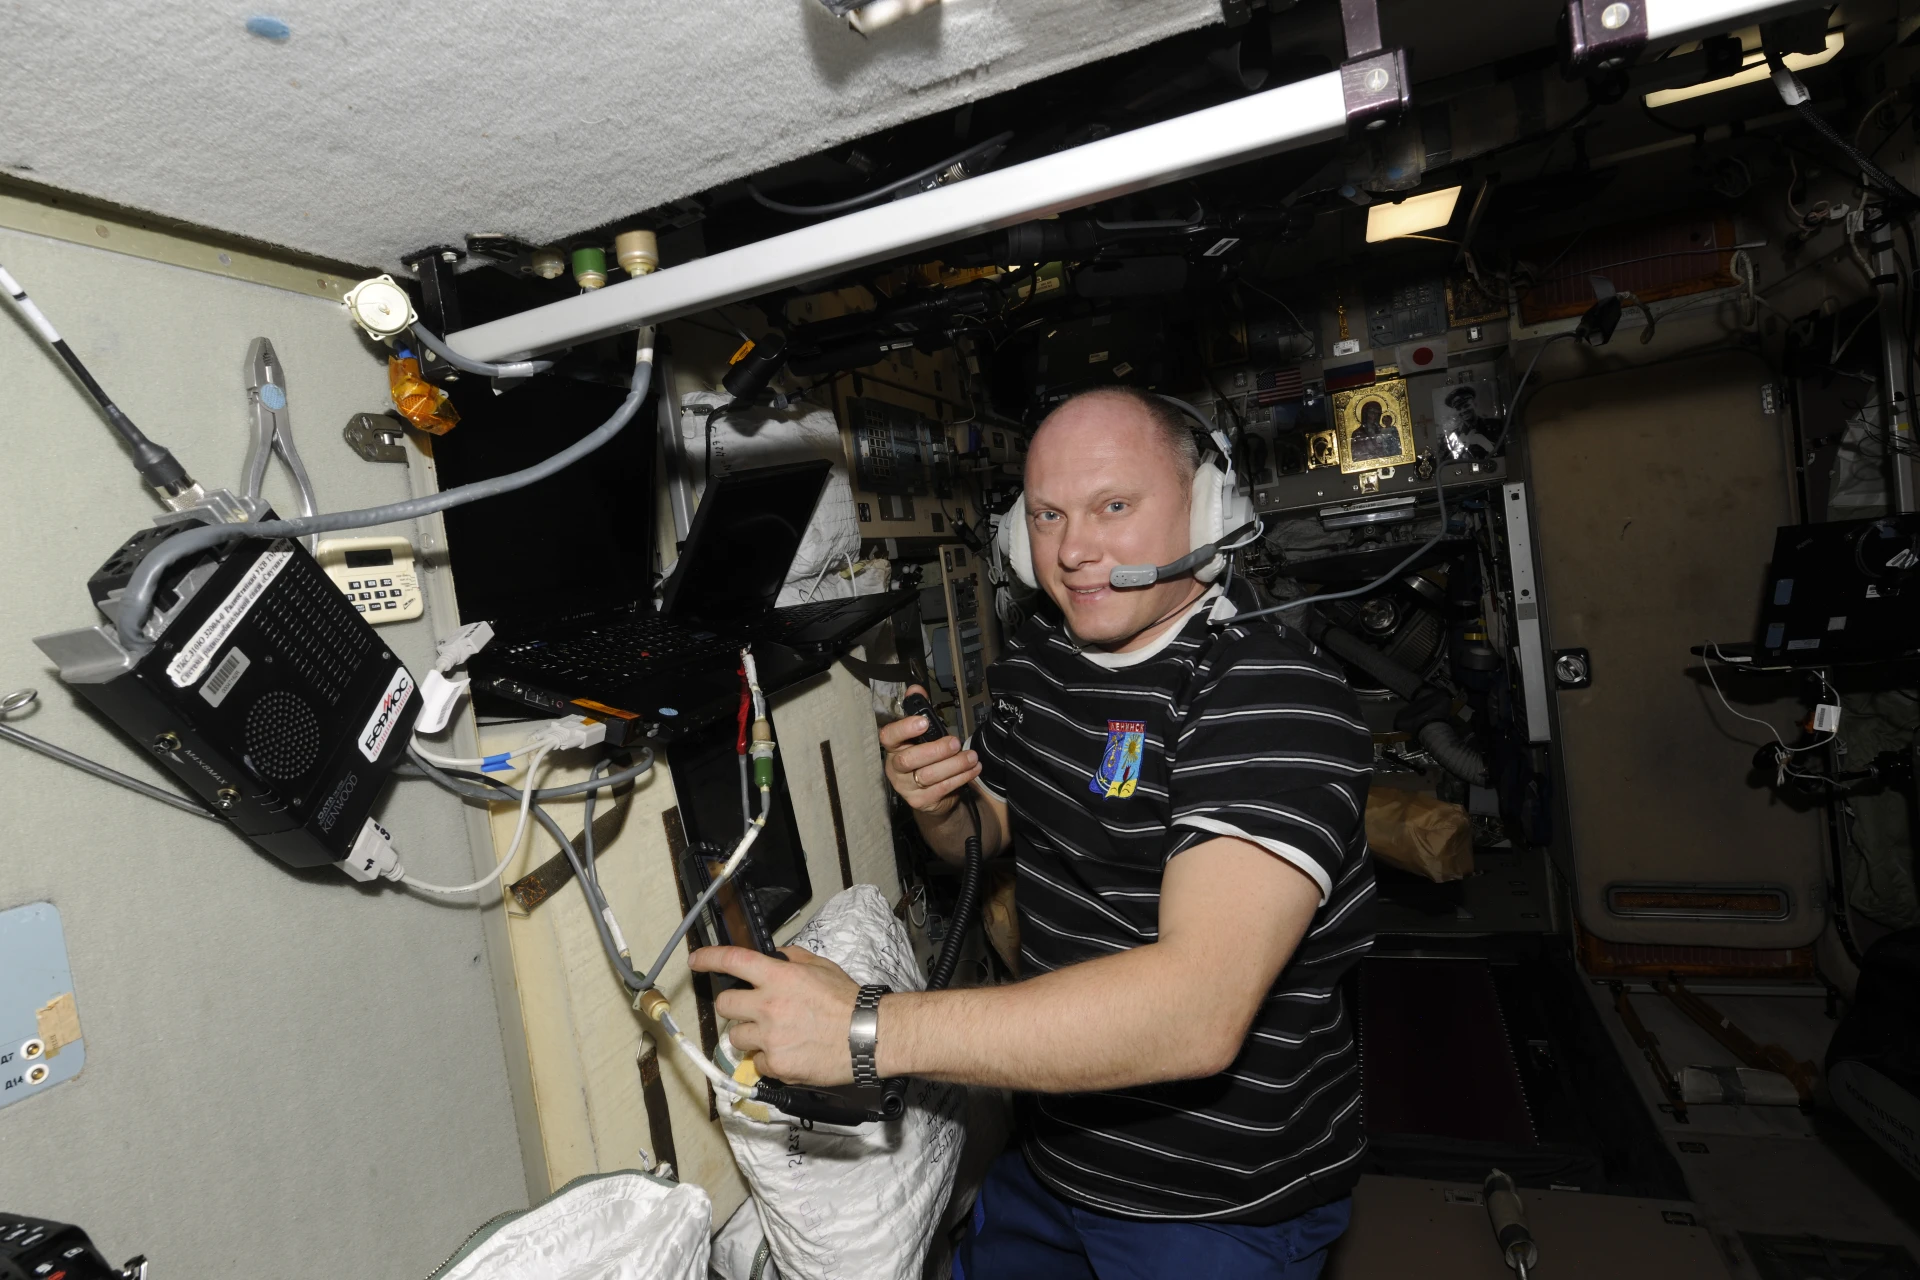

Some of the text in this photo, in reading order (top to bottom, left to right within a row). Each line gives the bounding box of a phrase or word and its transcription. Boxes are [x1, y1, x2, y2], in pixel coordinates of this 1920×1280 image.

[255, 559, 268, 576] УКВ
[180, 654, 205, 684] Система
[1110, 722, 1145, 732] ЛЕНИНСК
[317, 796, 334, 820] DATA
[322, 774, 358, 834] KENWOOD
[5, 1076, 24, 1090] Д14
